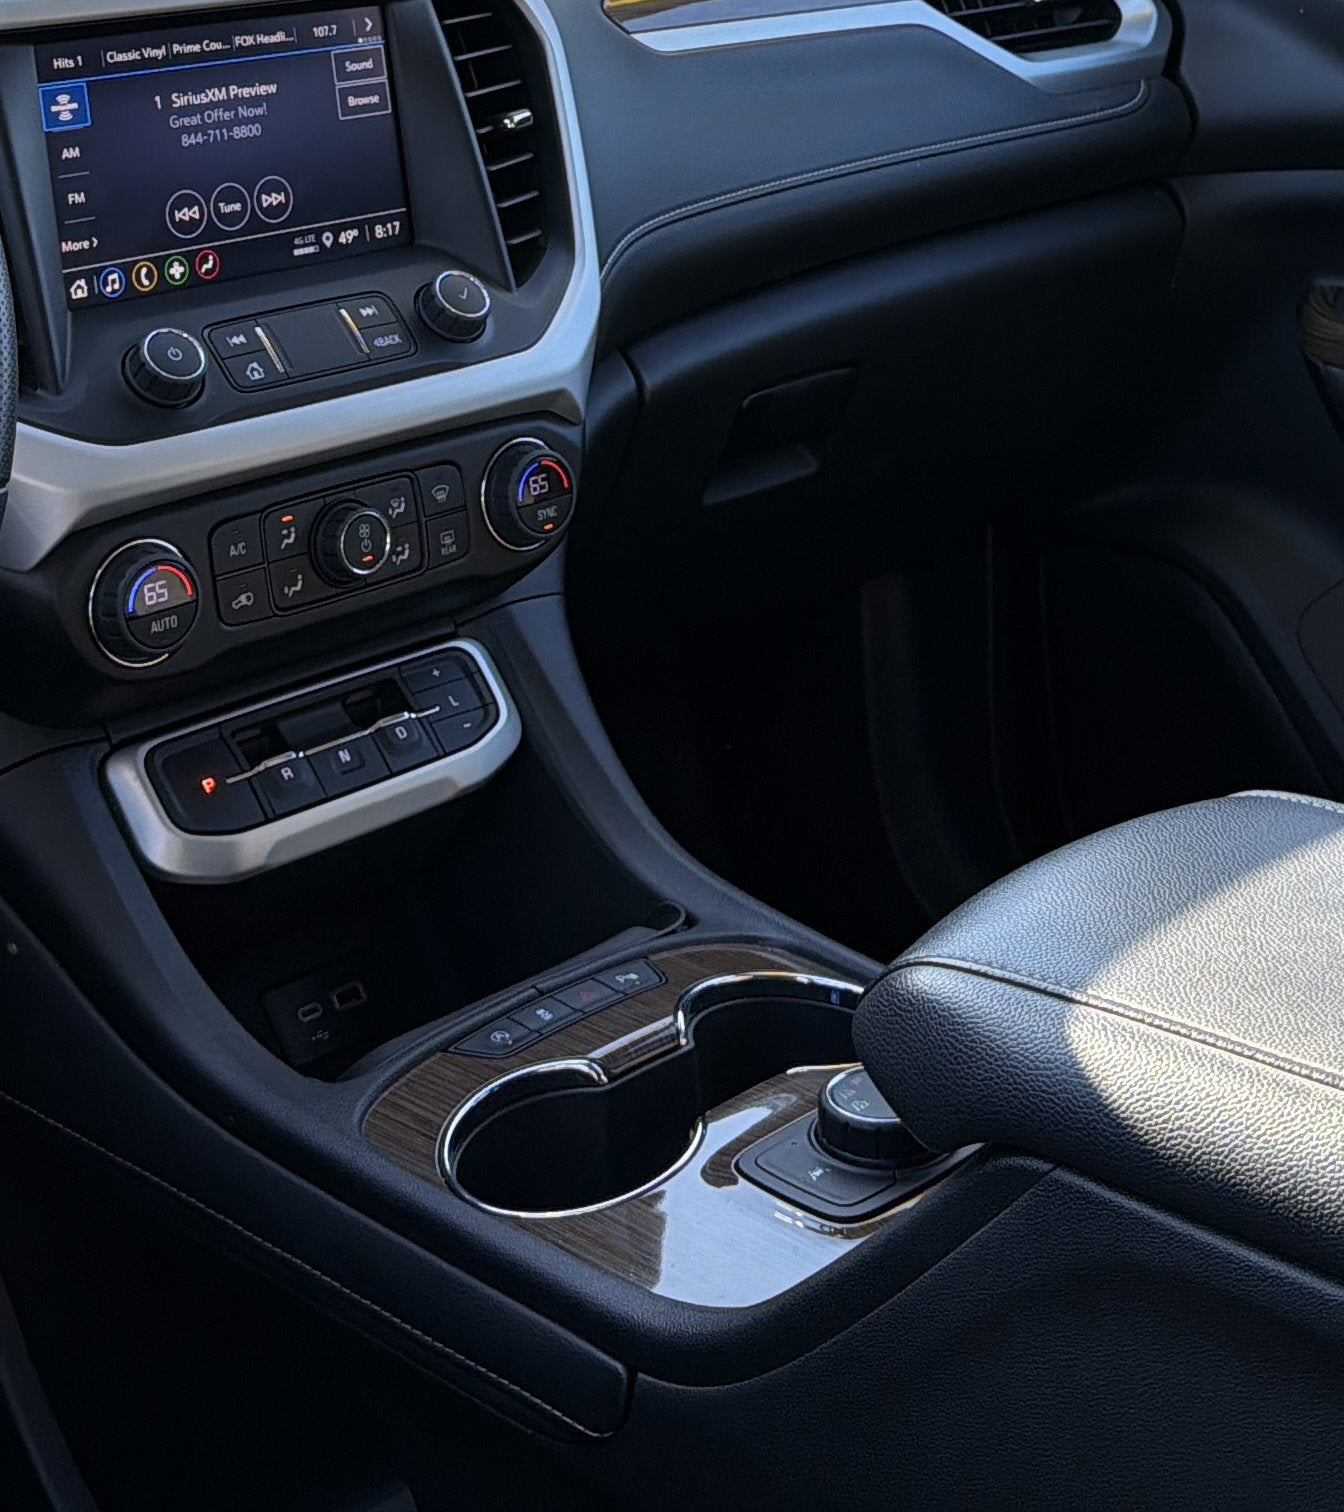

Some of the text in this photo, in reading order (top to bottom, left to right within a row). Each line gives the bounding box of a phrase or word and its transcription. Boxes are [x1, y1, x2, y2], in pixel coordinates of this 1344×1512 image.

[312, 24, 338, 38] 107.7
[172, 39, 231, 55] Prime Cou...
[234, 35, 256, 47] FOX
[106, 45, 167, 63] Classic Vinyl
[53, 55, 83, 70] Hits 1
[345, 58, 374, 72] Sound
[155, 82, 278, 110] 1 SiriusXM Preview
[348, 92, 381, 107] Browse
[169, 102, 269, 129] Great Offer Now!
[180, 122, 263, 148] 844-711-8800
[61, 146, 81, 161] AM
[67, 191, 87, 206] FM
[217, 201, 243, 215] Tune
[374, 221, 401, 240] 8:17
[61, 239, 91, 254] More
[293, 233, 317, 246] 4G LTE
[529, 473, 550, 497] 65
[537, 506, 558, 522] SYNC
[229, 542, 248, 558] A/C
[440, 544, 457, 556] REAR
[143, 579, 169, 607] 65
[150, 614, 179, 635] AUTO
[447, 694, 460, 708] L
[394, 724, 408, 740] D
[337, 748, 352, 764] N
[280, 766, 295, 781] R
[200, 776, 217, 795] P
